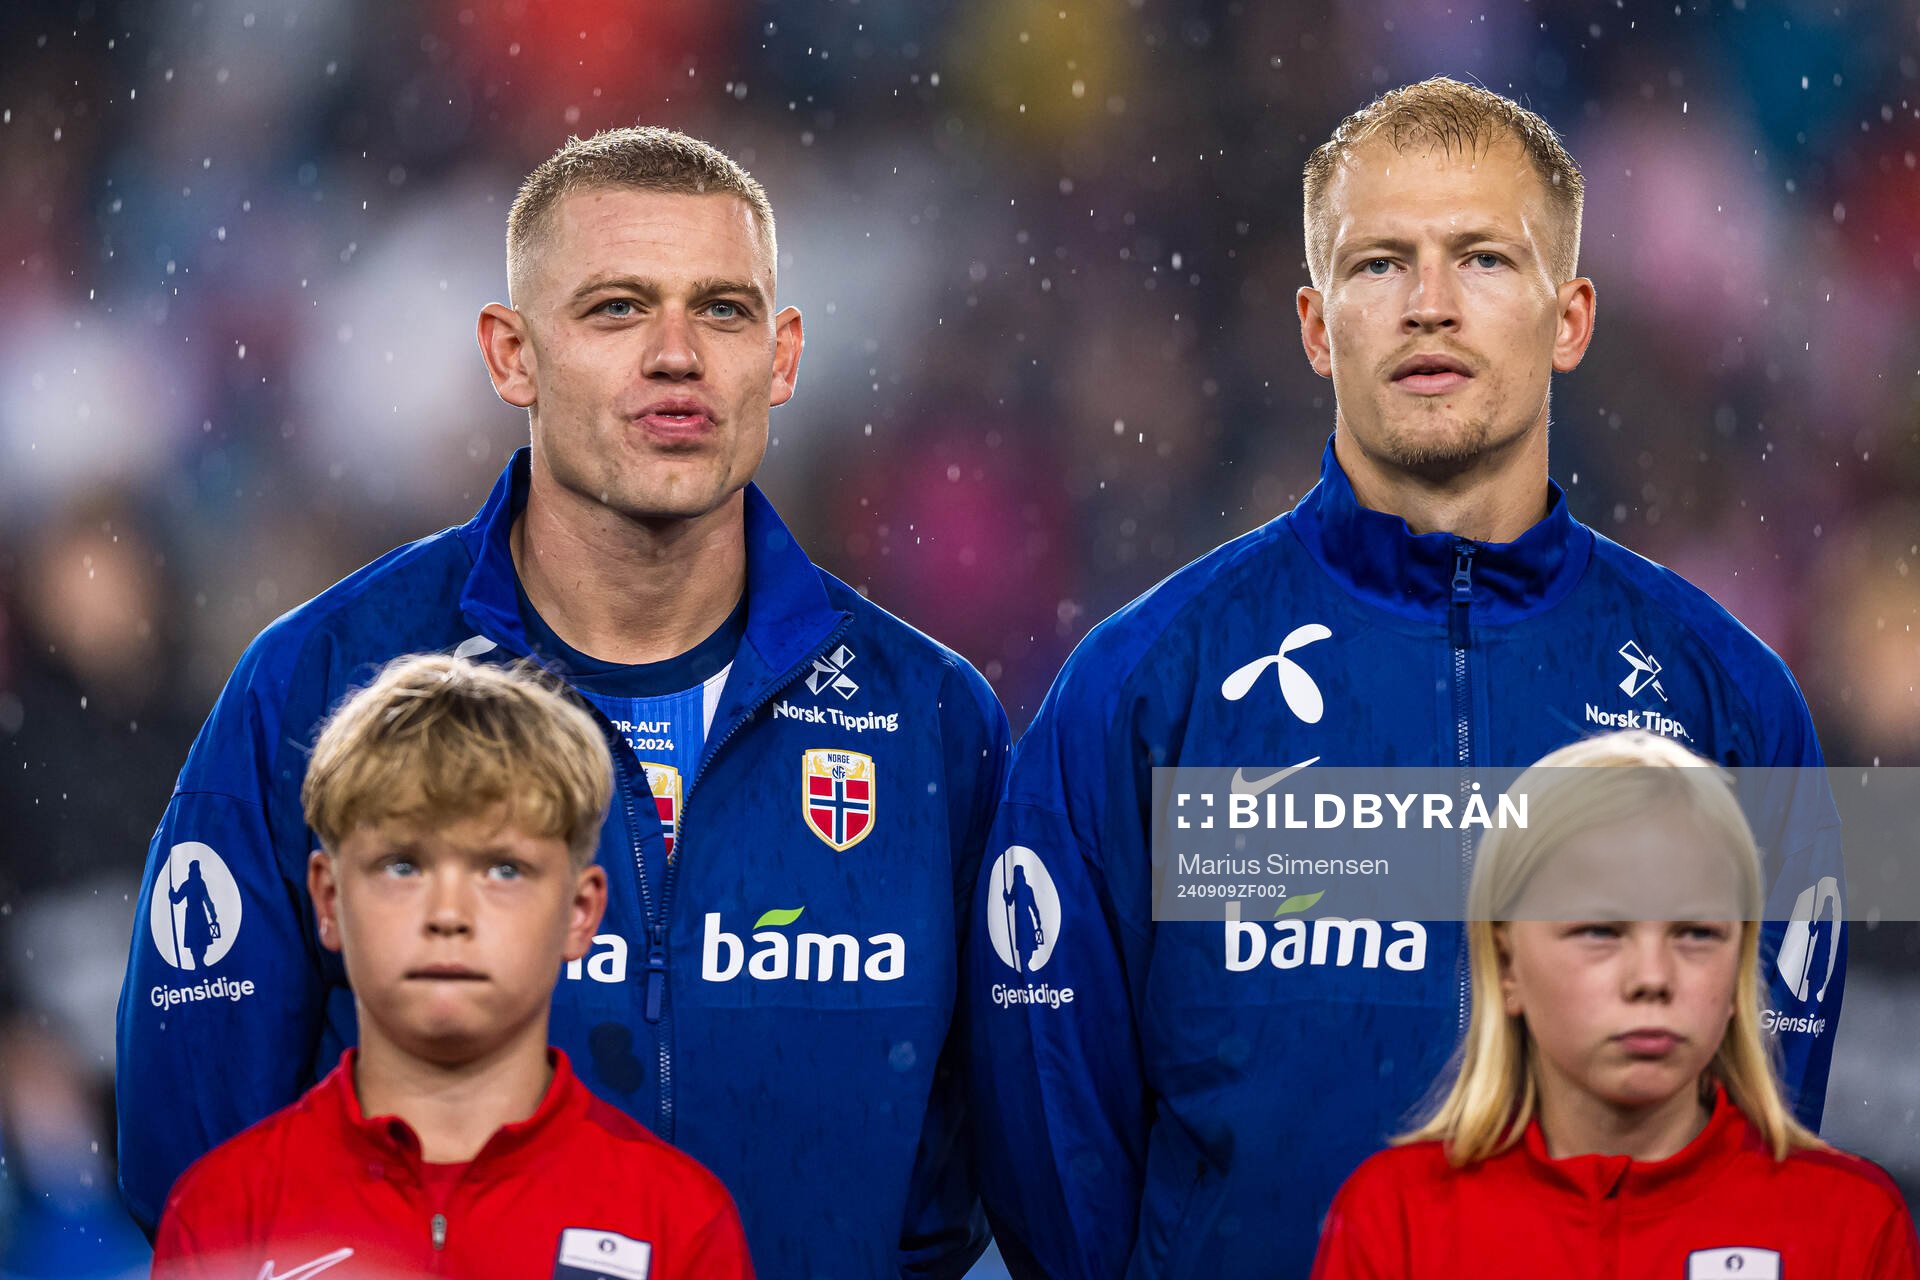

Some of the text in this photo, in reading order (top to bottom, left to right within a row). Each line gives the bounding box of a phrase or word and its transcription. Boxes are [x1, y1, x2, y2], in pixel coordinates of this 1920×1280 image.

[773, 700, 899, 732] Norsk Tipping
[1586, 703, 1694, 742] Norsk Tipp
[828, 753, 850, 764] NORGE
[151, 976, 255, 1011] Gjensidige
[992, 983, 1074, 1009] Gjensidige
